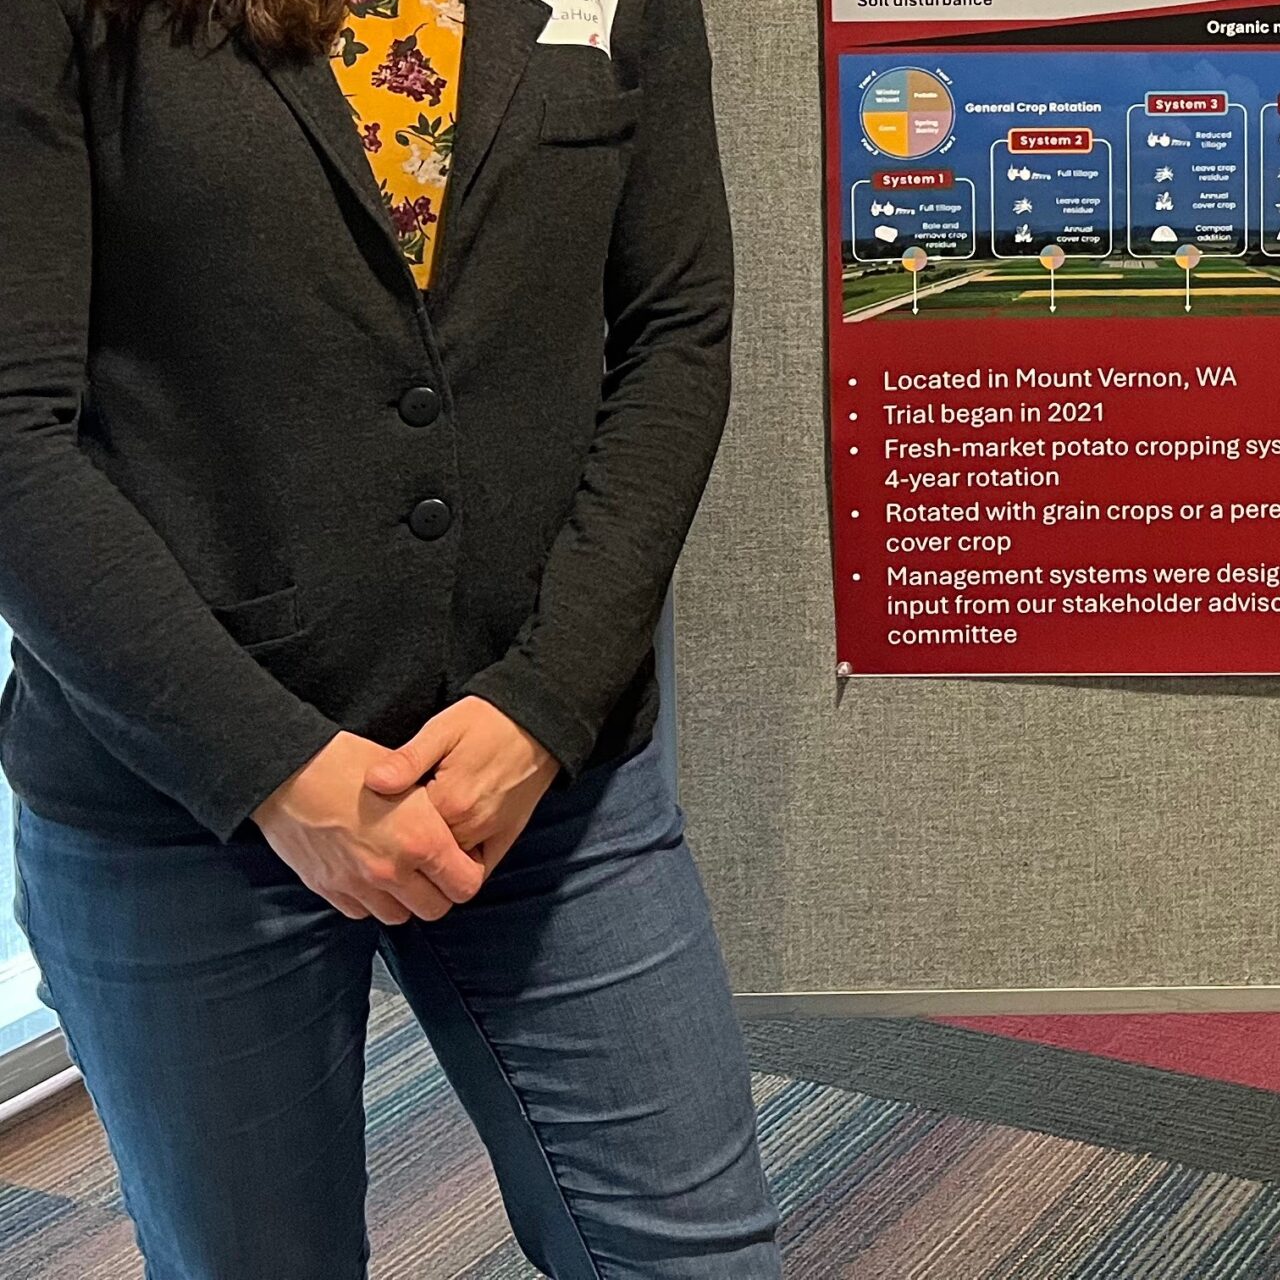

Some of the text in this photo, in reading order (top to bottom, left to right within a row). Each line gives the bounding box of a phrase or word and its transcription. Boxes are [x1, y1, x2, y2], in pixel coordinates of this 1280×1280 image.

[1206, 19, 1270, 37] Organic
[964, 100, 1102, 116] General Crop Rotation
[1155, 98, 1219, 113] System 3
[1020, 134, 1083, 149] System 2
[882, 173, 944, 188] System 1
[884, 366, 1238, 391] Located in Mount Vernon, WA
[882, 402, 1103, 428] Trial began in 2021
